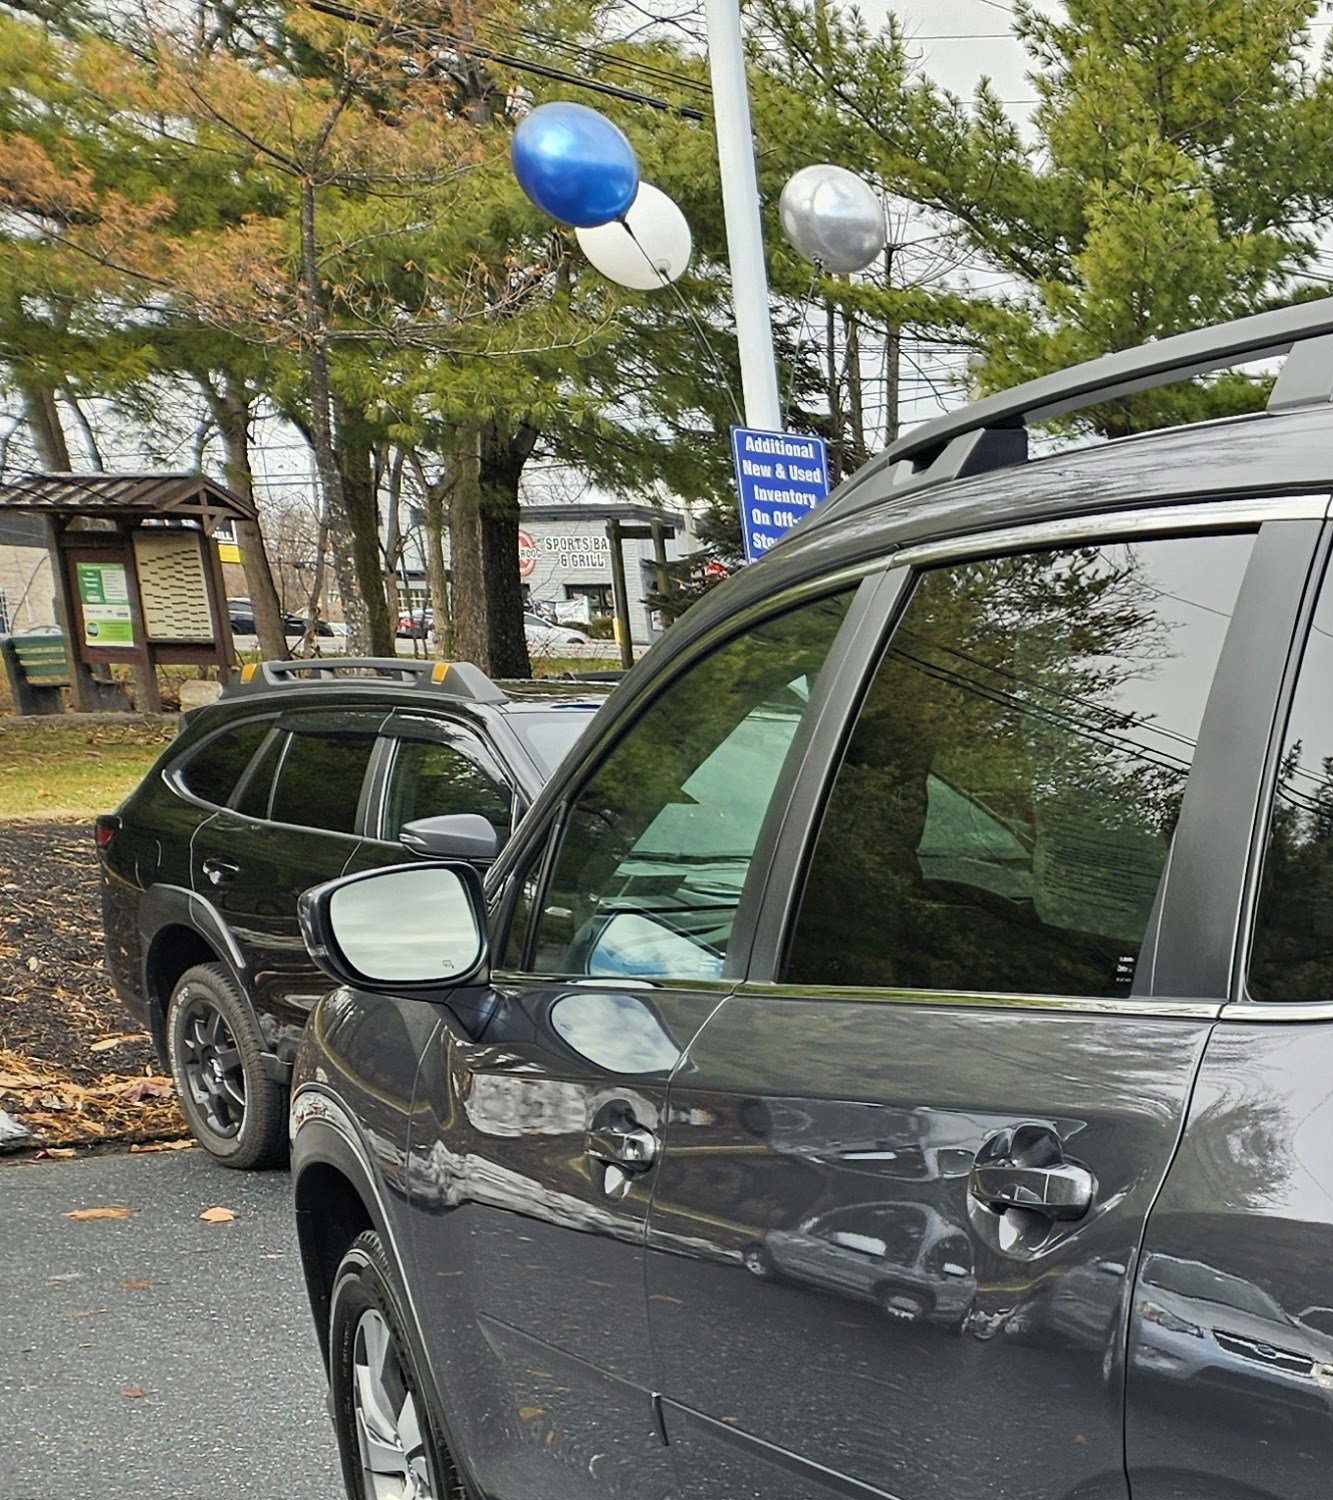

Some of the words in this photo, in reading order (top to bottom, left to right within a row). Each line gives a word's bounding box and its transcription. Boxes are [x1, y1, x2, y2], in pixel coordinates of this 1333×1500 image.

[745, 436, 816, 459] Additional
[742, 460, 772, 478] New
[775, 463, 787, 480] &
[789, 464, 823, 483] Used
[753, 485, 817, 509] Inventory
[751, 508, 771, 526] On
[773, 510, 802, 528] Off-
[545, 537, 589, 551] SPORTS
[593, 537, 608, 550] BA
[752, 532, 778, 550] Sto
[571, 554, 604, 567] GRILL
